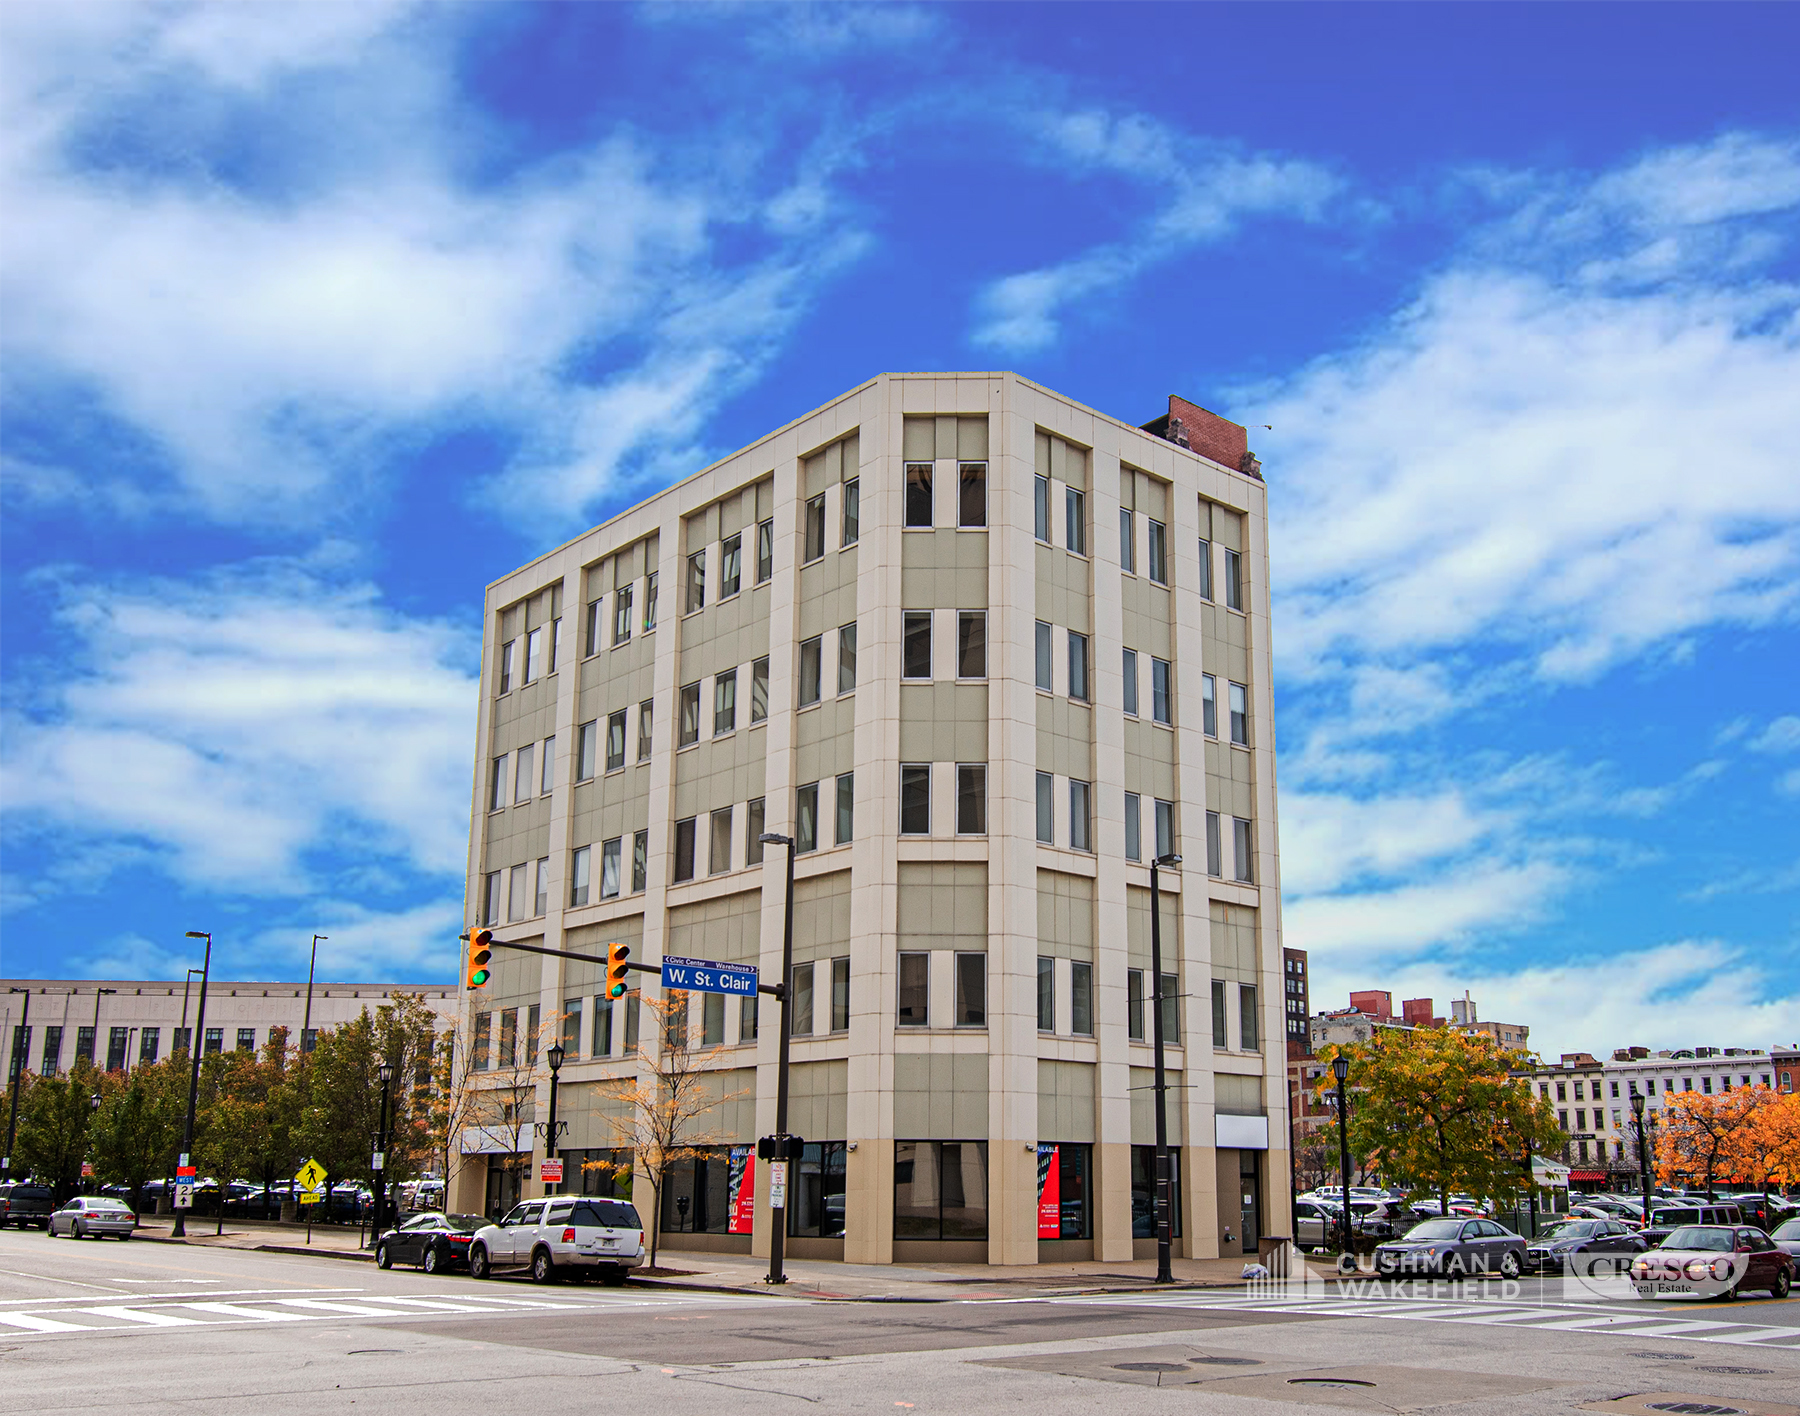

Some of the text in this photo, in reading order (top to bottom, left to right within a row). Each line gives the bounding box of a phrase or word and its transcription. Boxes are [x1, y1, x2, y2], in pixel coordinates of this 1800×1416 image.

[669, 956, 706, 967] Civic Center
[715, 962, 750, 972] Warehouse
[668, 968, 751, 991] W. St. Clair
[180, 1185, 189, 1195] 2
[302, 1193, 319, 1202] AHEAD
